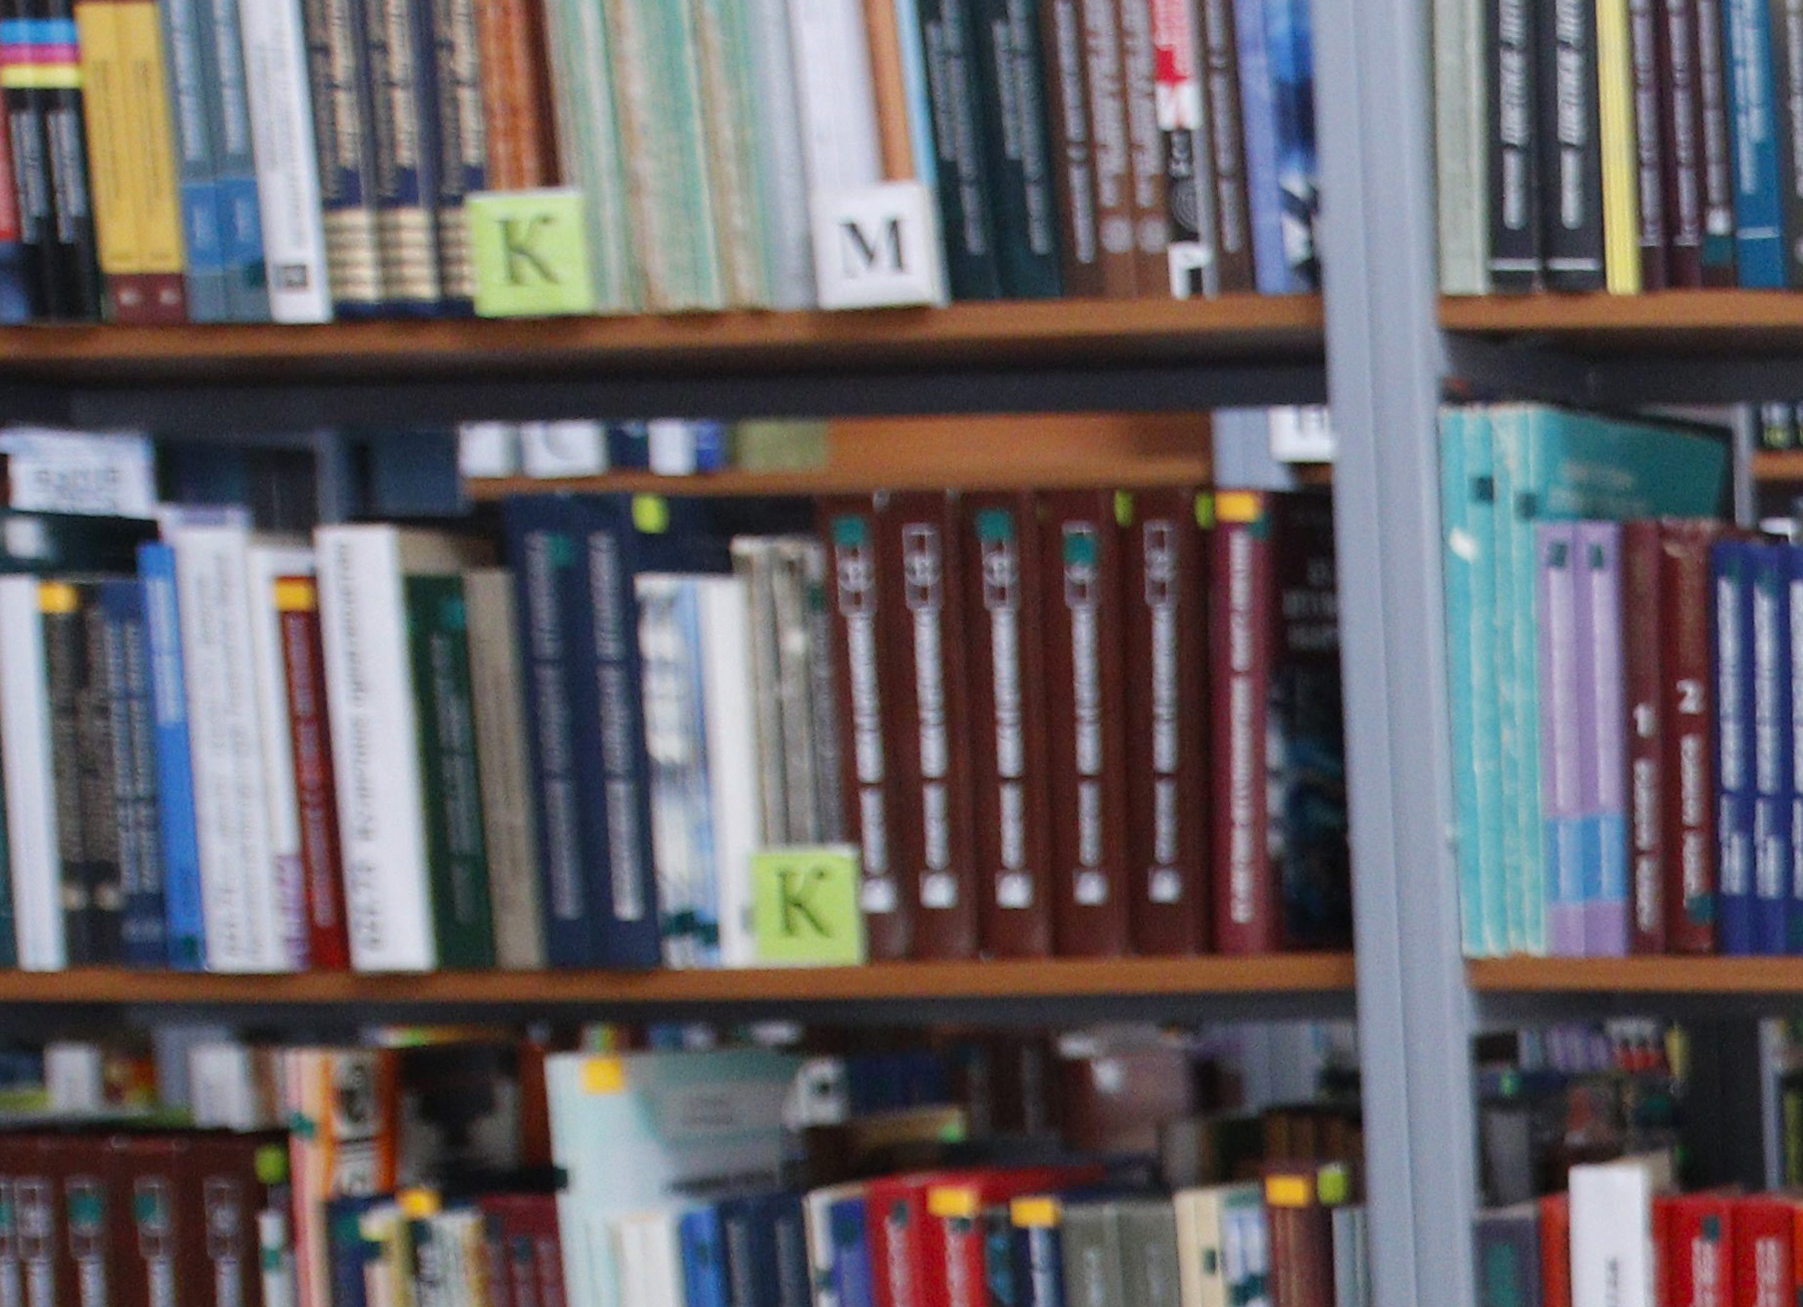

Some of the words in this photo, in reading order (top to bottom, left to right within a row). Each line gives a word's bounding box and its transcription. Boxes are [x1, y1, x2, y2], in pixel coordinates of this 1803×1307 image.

[496, 214, 561, 287] К
[841, 216, 910, 277] М
[775, 867, 831, 940] К
